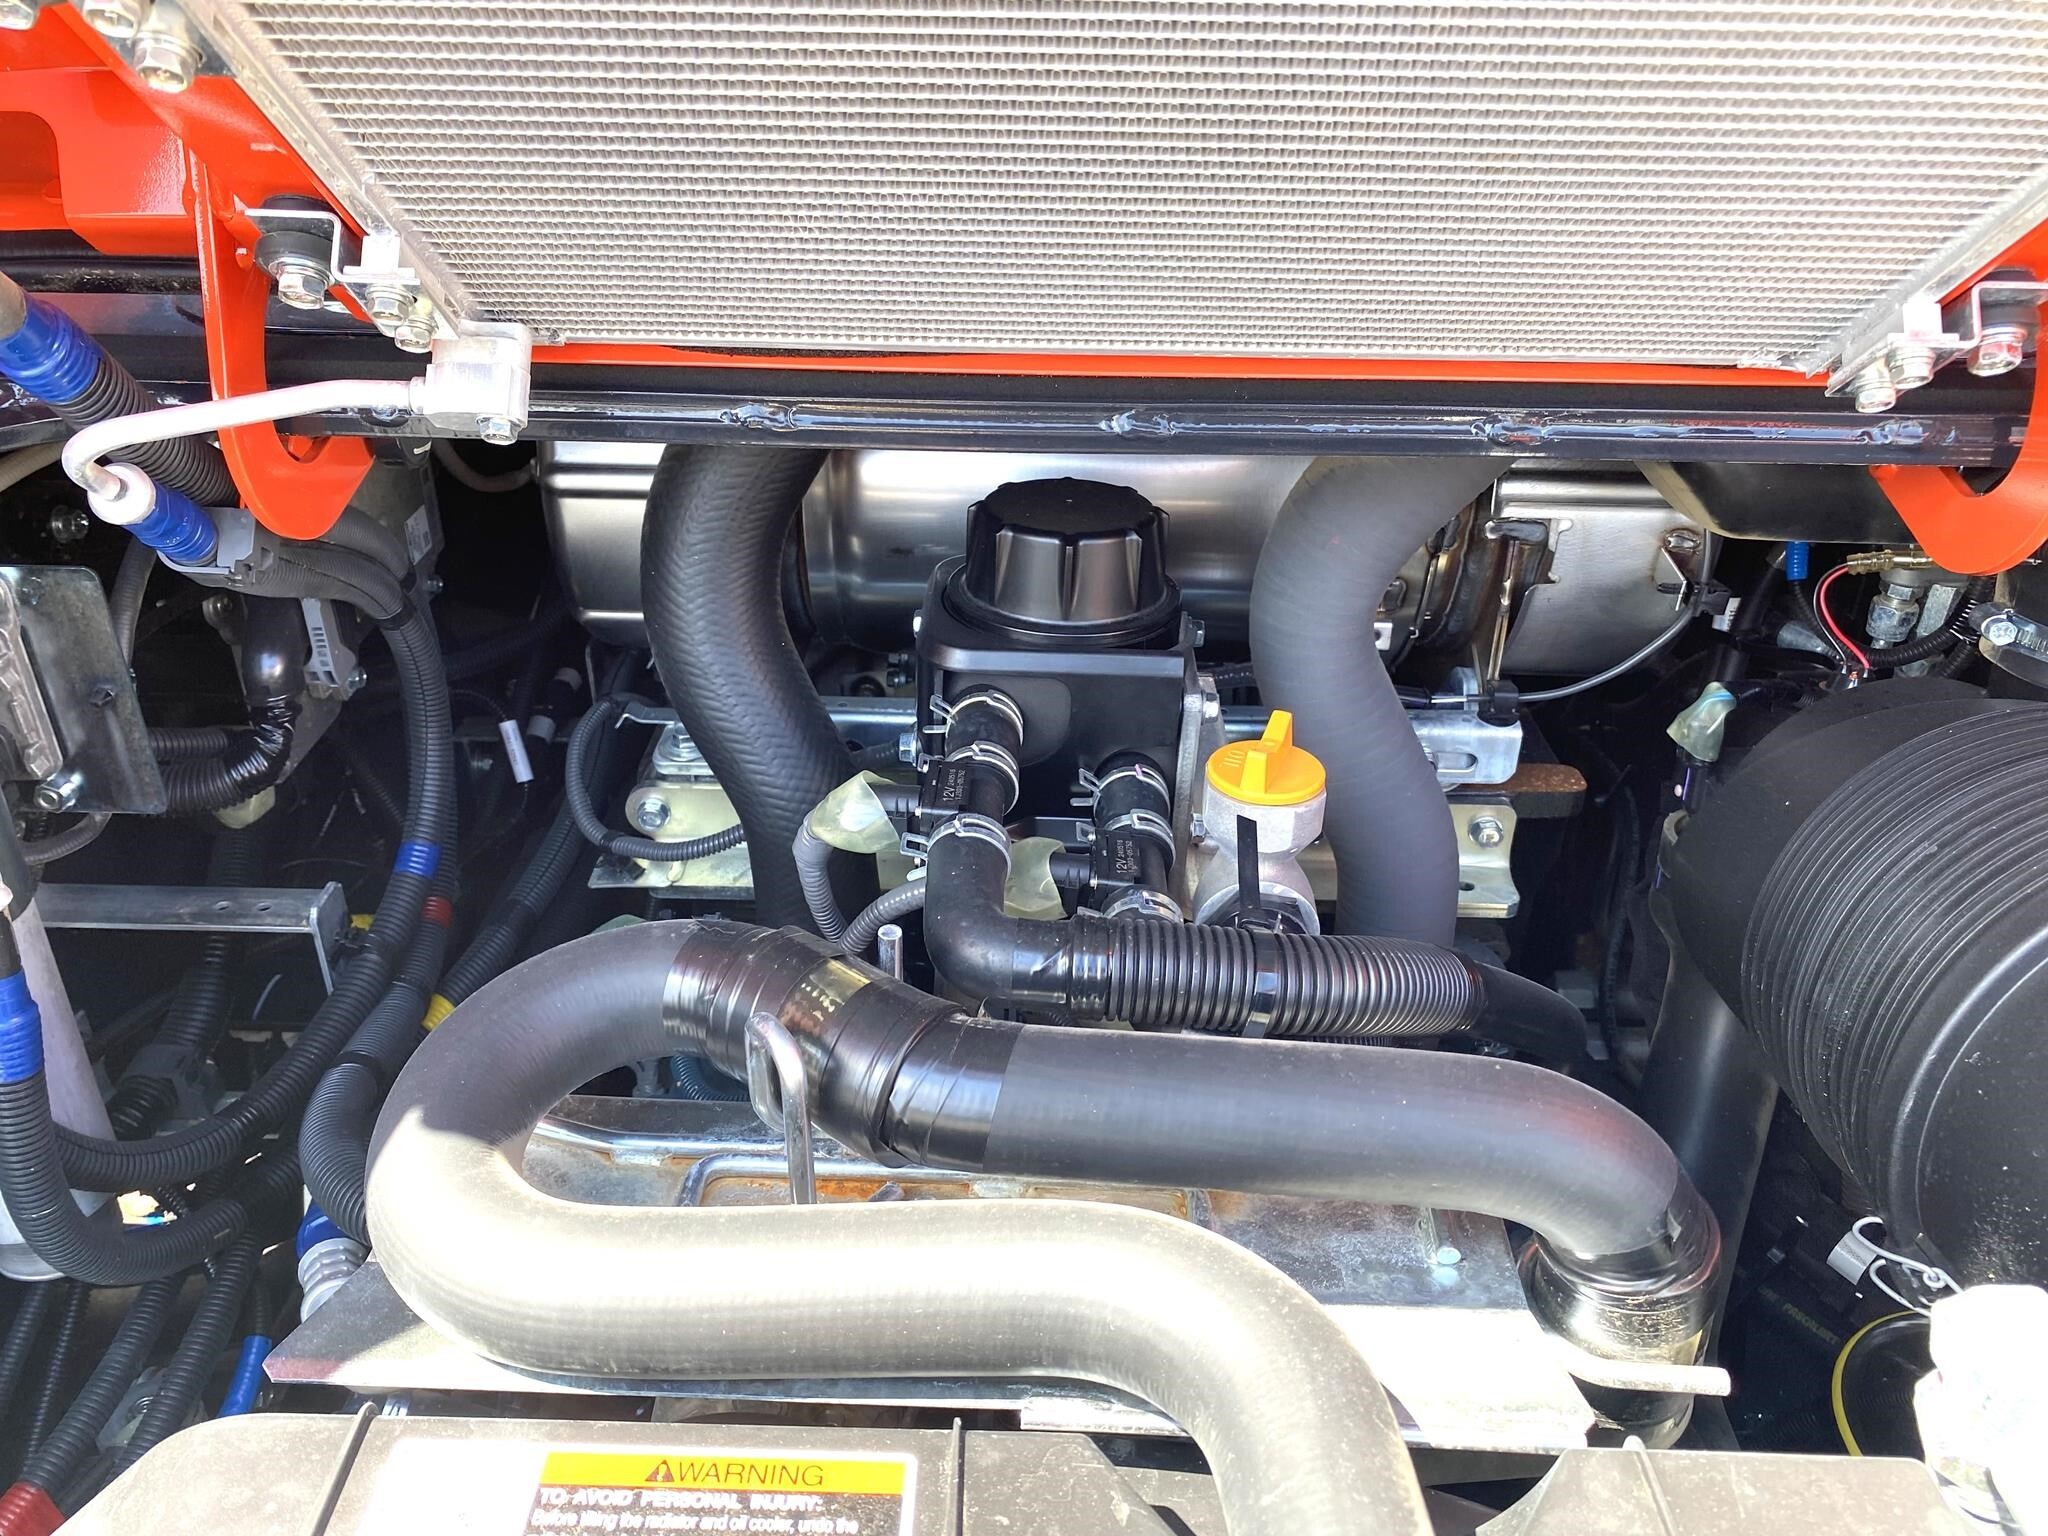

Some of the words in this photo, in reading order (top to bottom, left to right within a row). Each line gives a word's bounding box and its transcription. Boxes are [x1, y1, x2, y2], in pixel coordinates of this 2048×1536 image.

[943, 786, 955, 801] 12V
[1115, 857, 1127, 873] 12V
[678, 1461, 824, 1487] WARNING
[540, 1486, 568, 1506] TO
[571, 1487, 636, 1507] AVOID
[639, 1489, 742, 1511] PERSONAL
[749, 1493, 825, 1513] INJURY:
[530, 1507, 578, 1527] Before
[619, 1510, 644, 1528] the
[644, 1511, 700, 1530] radiator
[700, 1514, 728, 1531] and
[729, 1515, 748, 1532] oil
[749, 1515, 795, 1535] cooler,
[797, 1517, 834, 1533] undo
[835, 1516, 859, 1534] the
